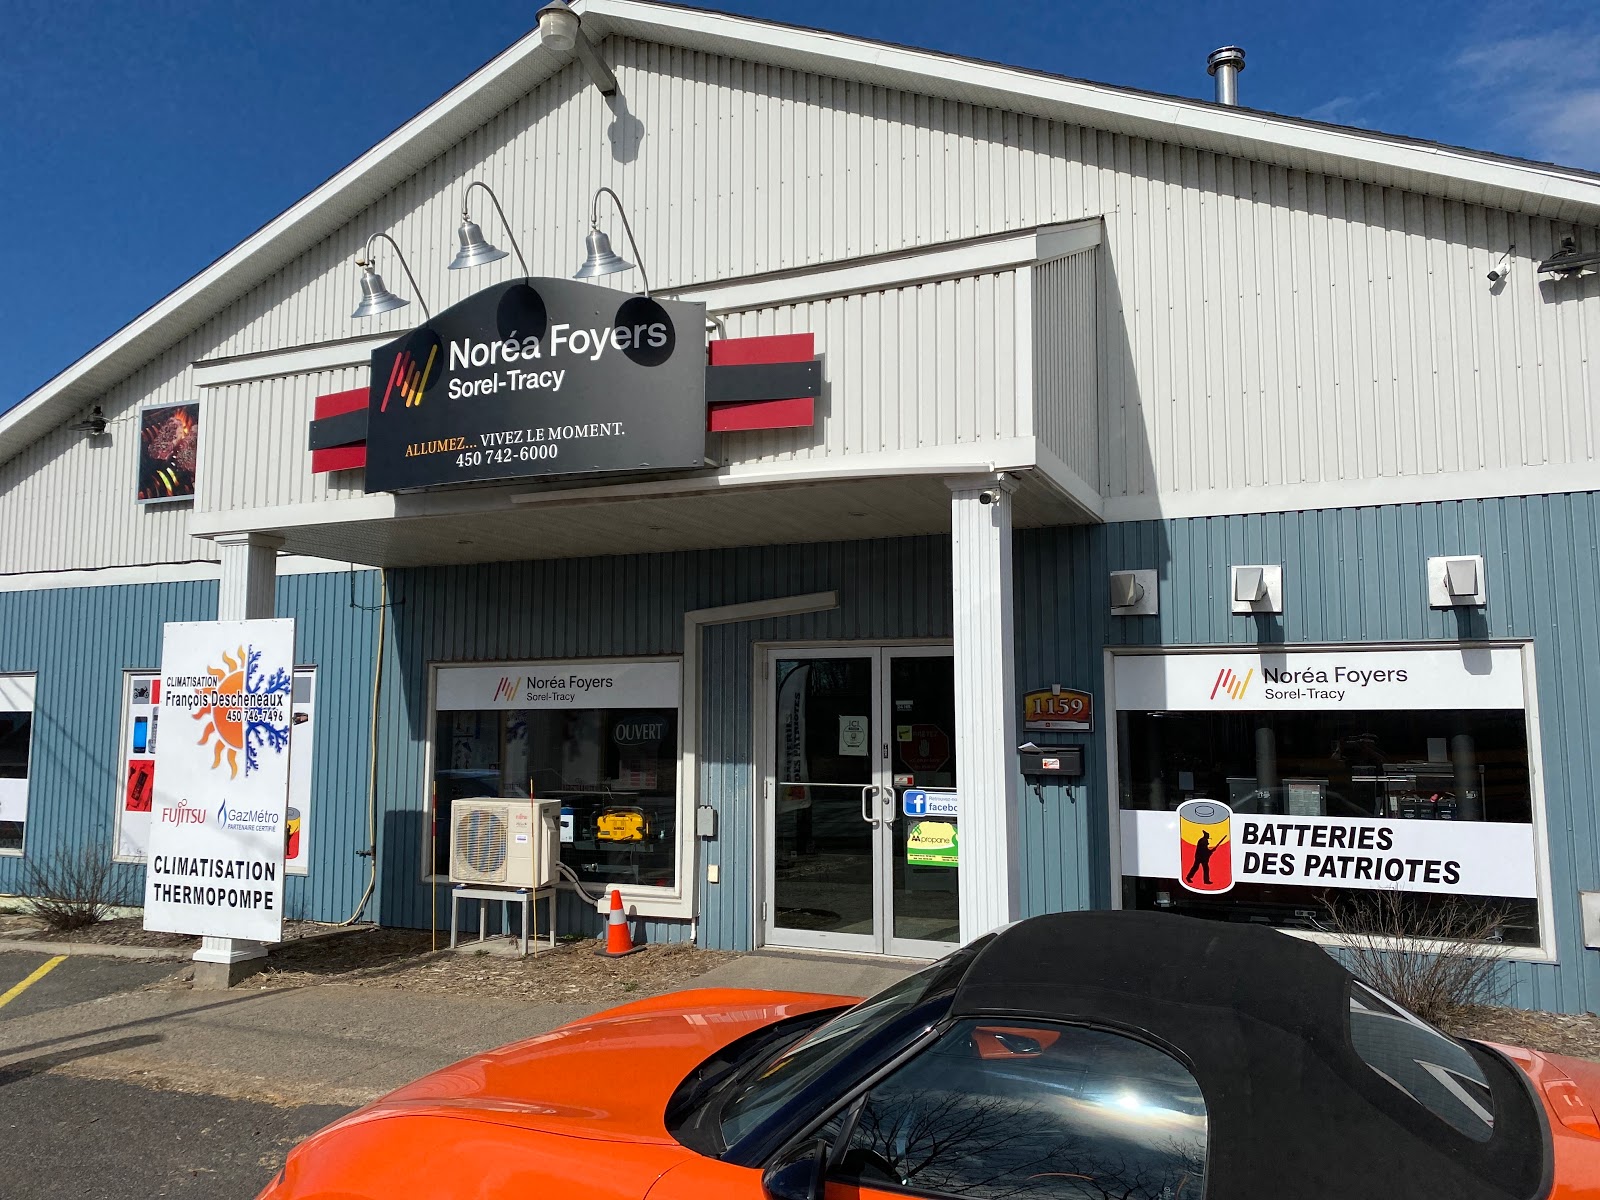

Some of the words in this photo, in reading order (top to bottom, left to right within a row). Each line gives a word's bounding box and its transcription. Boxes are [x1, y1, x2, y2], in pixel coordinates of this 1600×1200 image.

[448, 331, 541, 371] Noréa
[550, 319, 668, 361] Foyers
[448, 367, 565, 400] Sorel-Tracy
[405, 436, 478, 457] ALLUMEZ...
[480, 430, 524, 448] VIVEZ
[527, 427, 545, 442] LE
[547, 421, 626, 440] MOMENT.
[455, 448, 482, 468] 450
[485, 443, 558, 465] 742-6000
[166, 676, 218, 688] CLIMATISATION
[526, 675, 566, 690] Noréa
[569, 675, 613, 692] Foyers
[1263, 666, 1329, 685] Noréa
[1334, 666, 1409, 688] Foyers
[165, 690, 209, 711] François
[211, 690, 284, 707] Descheneaux
[526, 691, 576, 703] Sorel-Tracy
[1264, 687, 1346, 702] Sorel-Tracy
[226, 710, 242, 722] 450
[1034, 698, 1083, 715] 1159
[615, 723, 663, 742] OUVERT
[162, 799, 207, 828] FUJITSU
[228, 809, 279, 824] GazMétro
[228, 823, 255, 832] PARTENAIRE
[1242, 822, 1394, 851] BATTERIES
[154, 855, 276, 881] CLIMATISATION
[1242, 850, 1296, 877] DES
[1303, 853, 1461, 886] PATRIOTES
[153, 883, 274, 910] THERMOPOMPE
